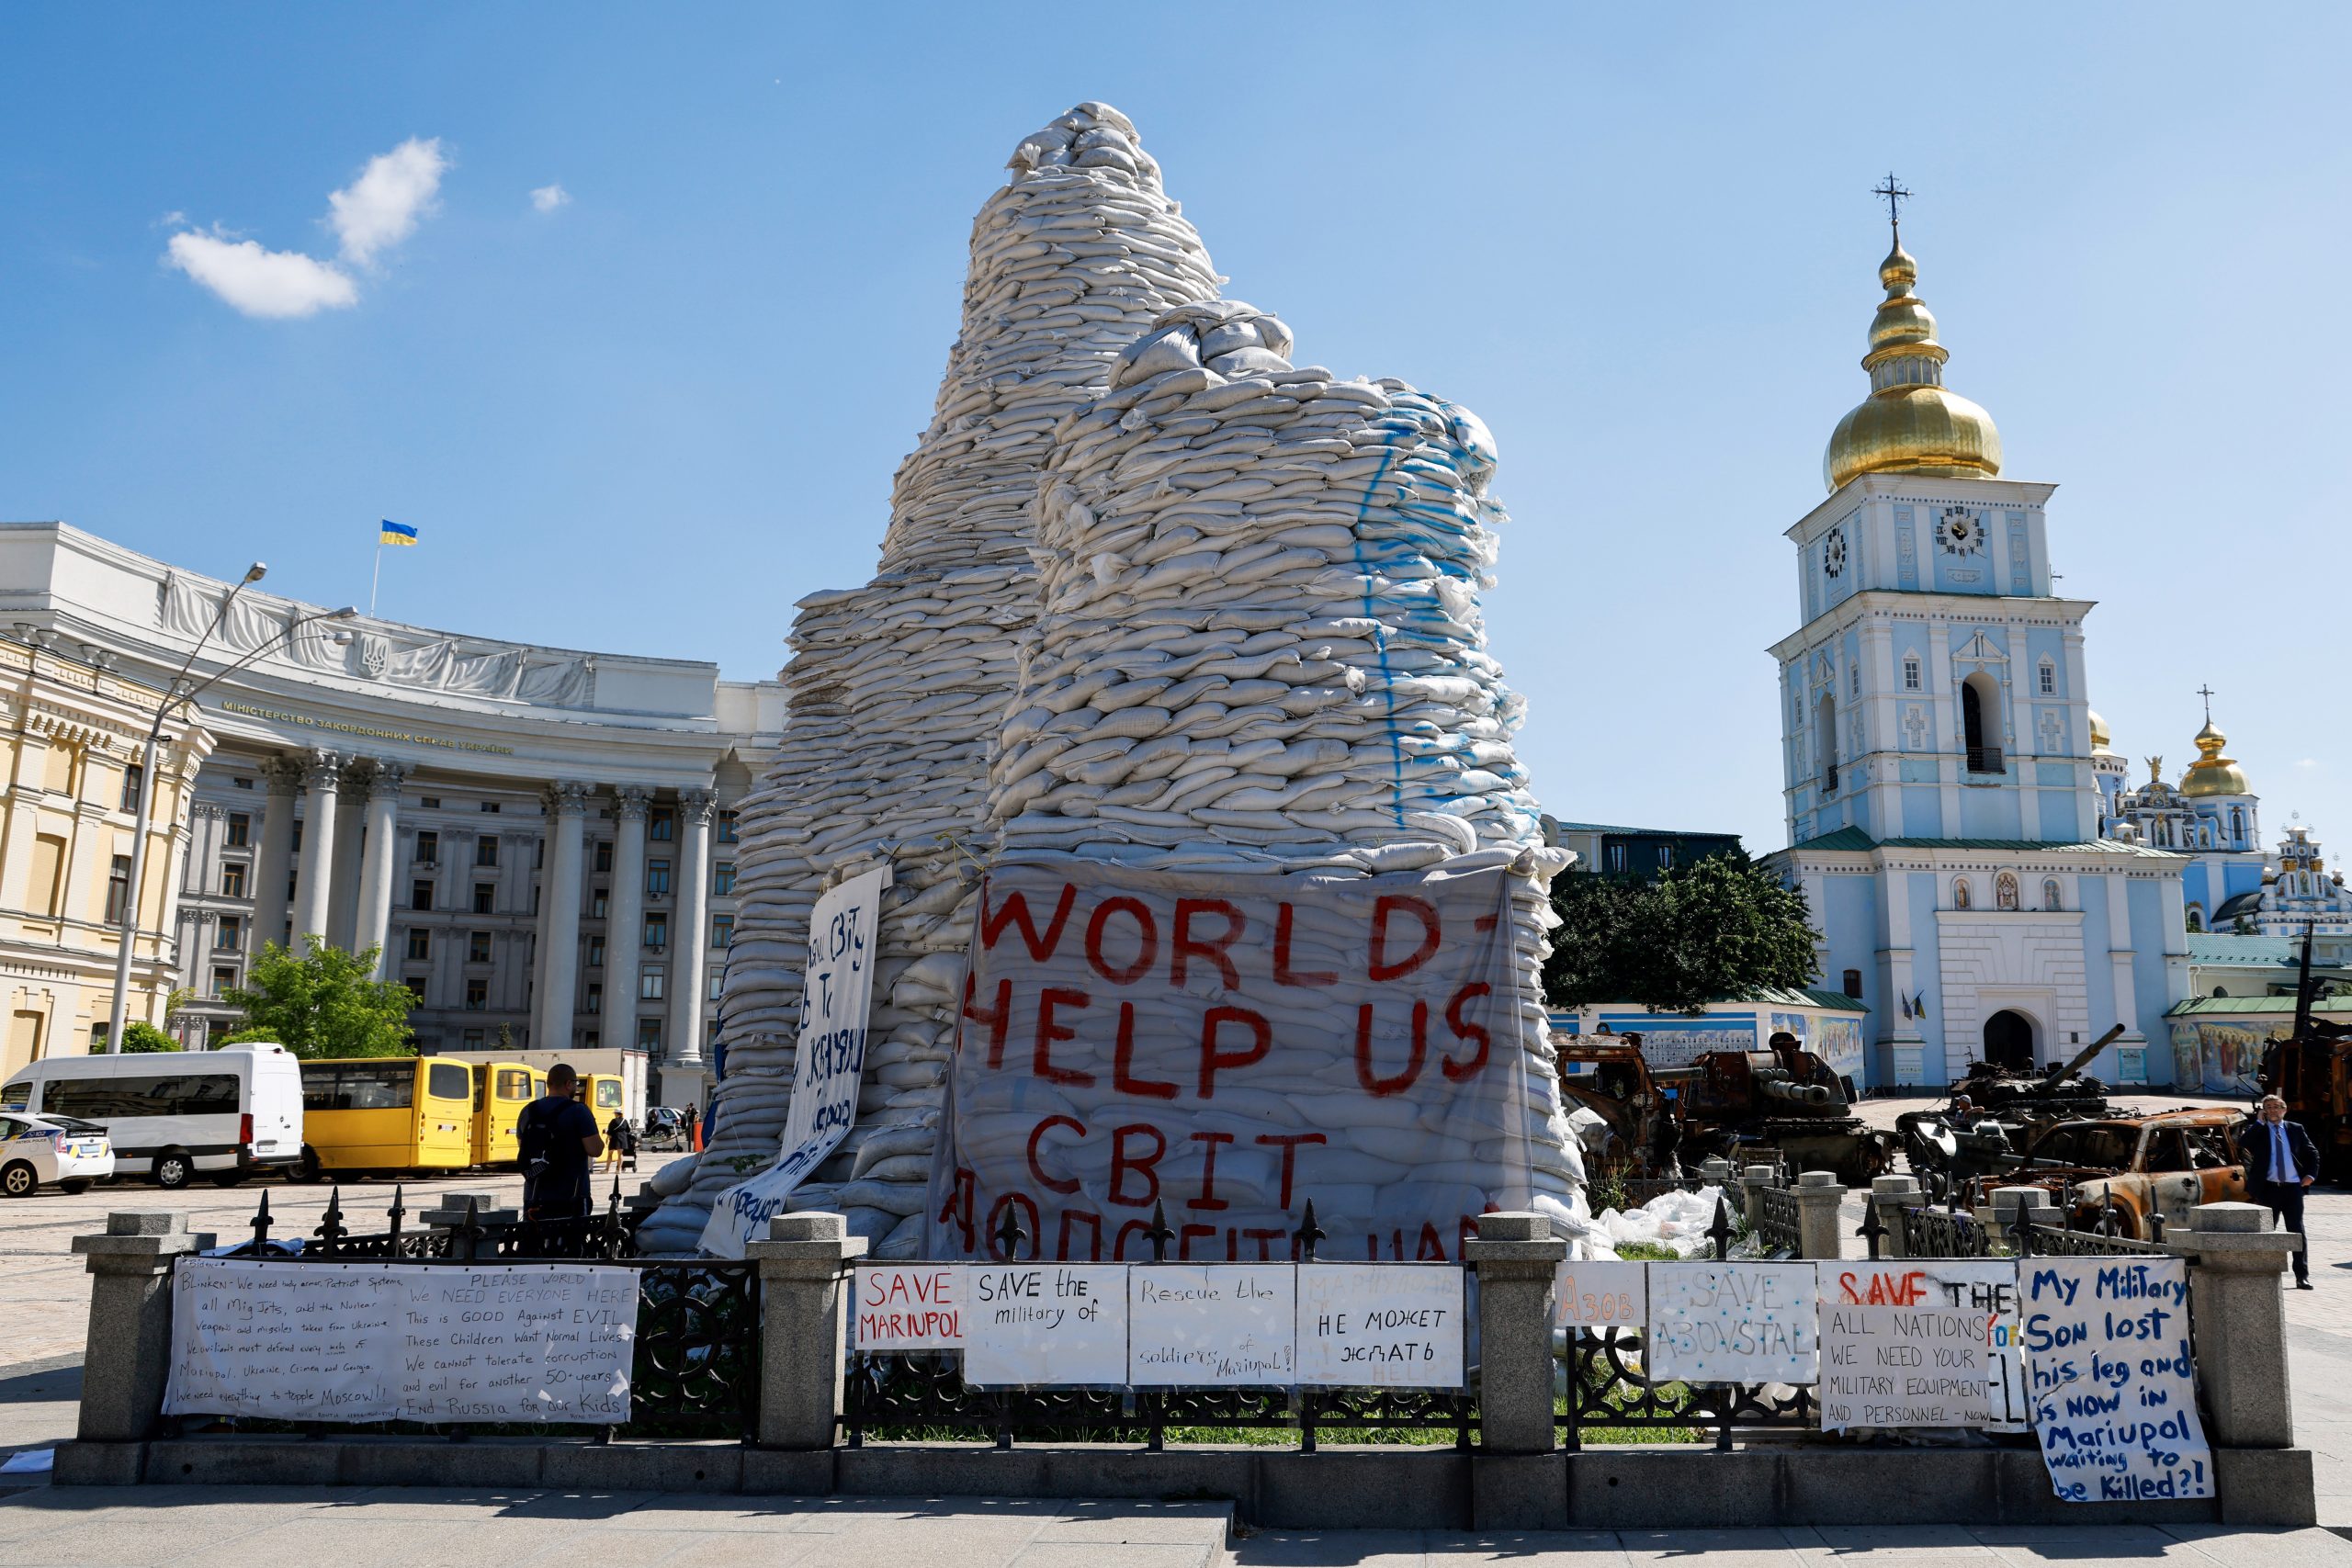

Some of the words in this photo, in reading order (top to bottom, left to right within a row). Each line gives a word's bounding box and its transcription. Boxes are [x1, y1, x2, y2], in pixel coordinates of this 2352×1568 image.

[221, 700, 314, 726] МІНІСТЕРСТВО
[316, 719, 411, 741] ЗАКОРДОННИХ
[413, 736, 457, 749] СПРАВ
[458, 740, 514, 755] УКРАЇНИ
[957, 972, 1269, 1100] HELP
[1354, 980, 1490, 1099] US
[237, 1275, 253, 1291] We
[470, 1274, 528, 1287] PLEASE
[542, 1274, 586, 1285] WORLD
[865, 1272, 953, 1307] SAVE
[978, 1271, 1042, 1302] SAVE
[1141, 1280, 1221, 1303] Rescue
[1237, 1276, 1273, 1301] the
[2030, 1269, 2081, 1306] My
[201, 1297, 218, 1312] all
[296, 1302, 315, 1313] and
[320, 1300, 334, 1312] the
[410, 1285, 430, 1303] We
[441, 1289, 486, 1303] NEED
[497, 1288, 572, 1303] EVERYONE
[587, 1288, 632, 1303] HERE
[1942, 1282, 2013, 1314] THE
[406, 1312, 429, 1325] This
[439, 1313, 449, 1324] is
[461, 1310, 504, 1323] GOOD
[572, 1309, 623, 1325] EVIL
[995, 1304, 1065, 1330] military
[1078, 1298, 1100, 1322] of
[1318, 1314, 1347, 1337] НЕ
[1365, 1309, 1447, 1331] МОЖЕТ
[2105, 1307, 2172, 1341] lost
[236, 1325, 252, 1335] and
[257, 1323, 293, 1335] missiles
[329, 1321, 346, 1331] from
[860, 1309, 963, 1343] MARIUPOL
[1832, 1312, 1875, 1335] ALL
[1894, 1313, 1986, 1342] NATIONS
[239, 1344, 263, 1353] must
[266, 1341, 295, 1353] defend
[406, 1335, 440, 1348] These
[450, 1332, 503, 1346] Children
[514, 1332, 541, 1343] Want
[546, 1330, 580, 1343] Normal
[1238, 1338, 1255, 1353] of
[405, 1355, 425, 1372] We
[485, 1351, 535, 1367] tolerate
[545, 1348, 617, 1367] corruption
[1138, 1347, 1218, 1367] soldiers
[1340, 1342, 1434, 1362] ЖДАТЬ
[1830, 1344, 1858, 1366] WE
[1876, 1346, 1923, 1368] NEED
[1932, 1347, 1975, 1369] YOUR
[289, 1363, 320, 1375] Crimea
[324, 1364, 339, 1373] and
[2032, 1357, 2078, 1390] his
[2091, 1349, 2131, 1389] leg
[401, 1381, 422, 1393] and
[428, 1378, 448, 1391] evil
[459, 1378, 479, 1390] for
[488, 1376, 533, 1390] another
[575, 1372, 612, 1393] years
[1829, 1376, 1894, 1397] MILITARY
[1906, 1377, 1991, 1399] EQUIPMENT
[175, 1387, 193, 1403] We
[219, 1389, 261, 1407] everything
[270, 1392, 282, 1401] to
[285, 1389, 315, 1405] topple
[580, 1393, 620, 1414] Kids
[1828, 1404, 1852, 1422] AND
[1863, 1404, 1949, 1424] PERSONNEL
[1963, 1410, 1990, 1422] NOW
[2032, 1396, 2058, 1424] is
[2046, 1409, 2191, 1450] Mariupol
[2146, 1447, 2180, 1468] to
[2053, 1475, 2088, 1502] be
